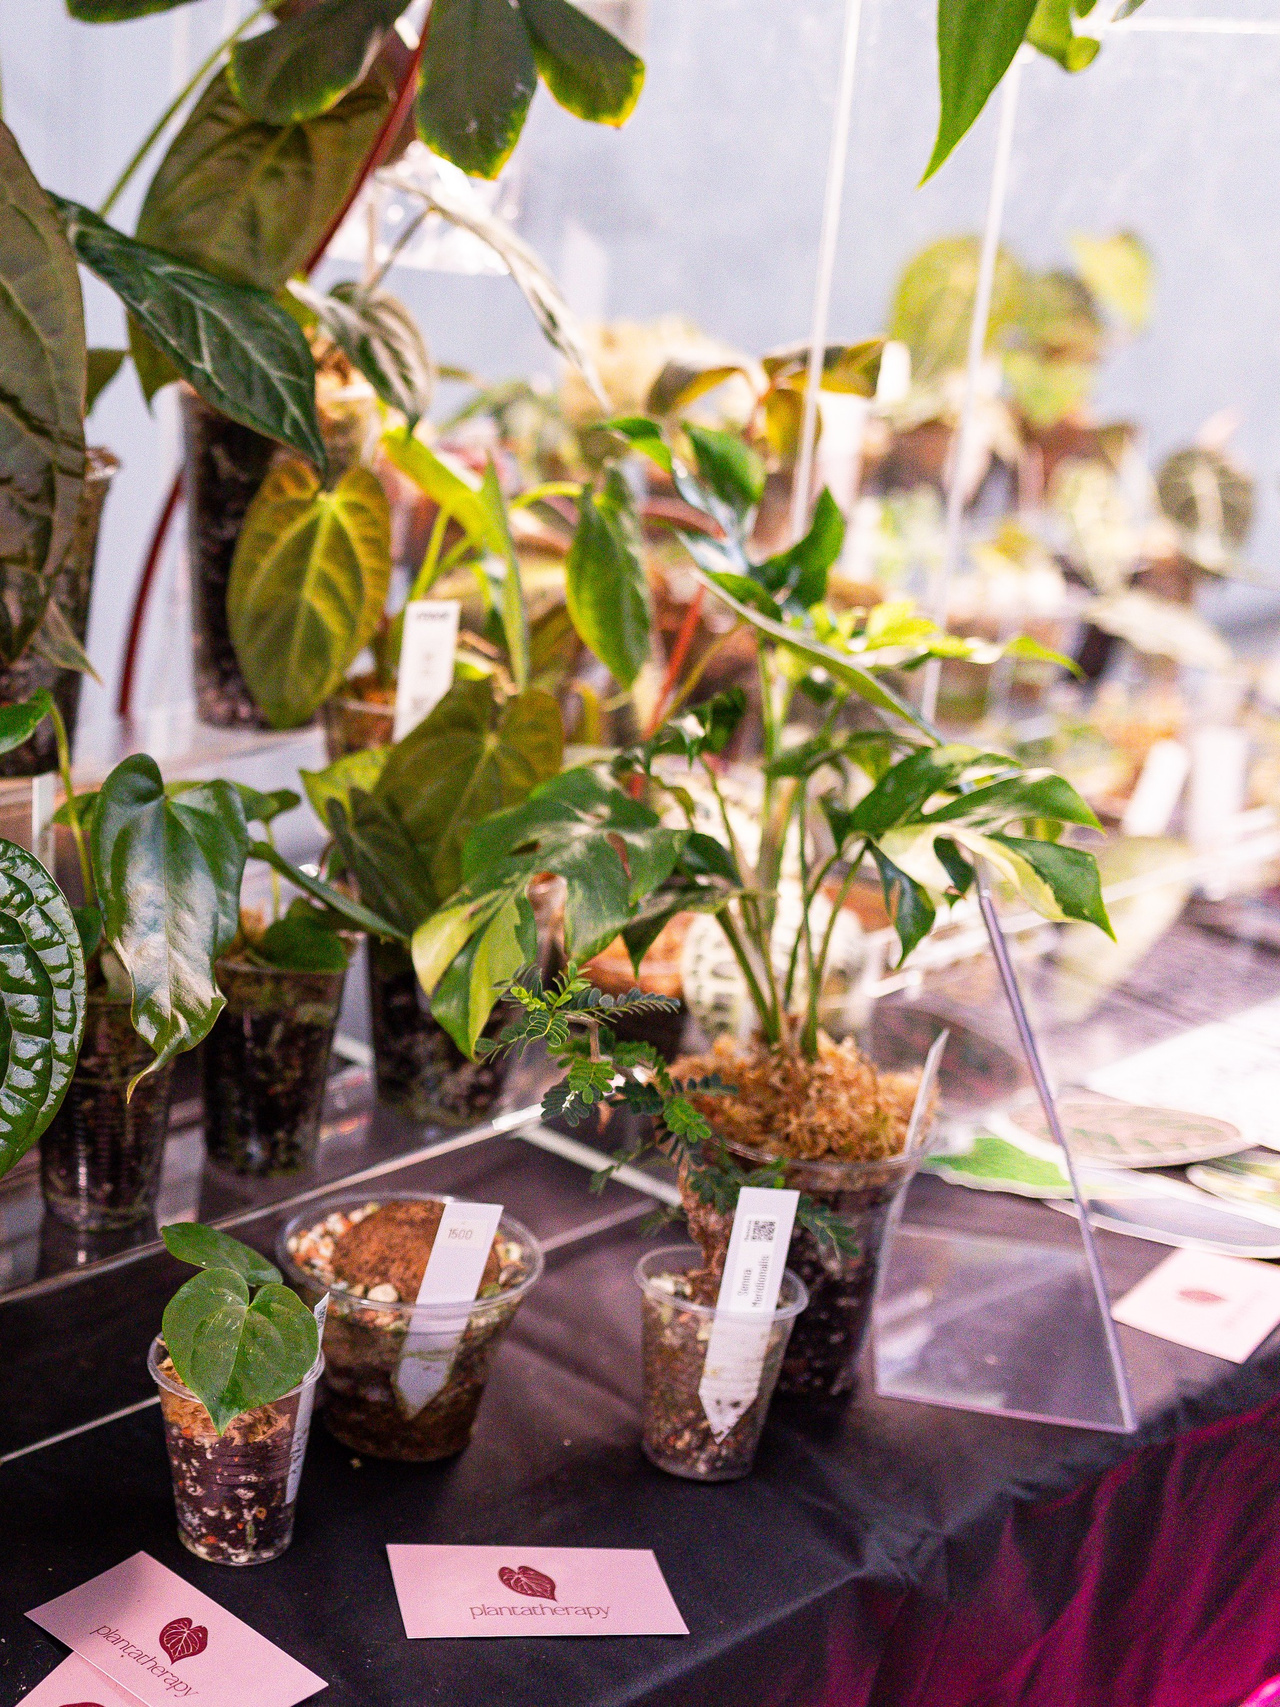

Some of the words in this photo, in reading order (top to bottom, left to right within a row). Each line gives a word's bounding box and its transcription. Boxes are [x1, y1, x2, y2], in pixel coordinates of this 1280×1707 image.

[447, 1228, 473, 1241] 1500
[738, 1269, 752, 1297] Senna
[752, 1255, 770, 1307] Meridionalis
[469, 1603, 610, 1619] plantatherapy
[89, 1625, 199, 1698] plantatherapy
